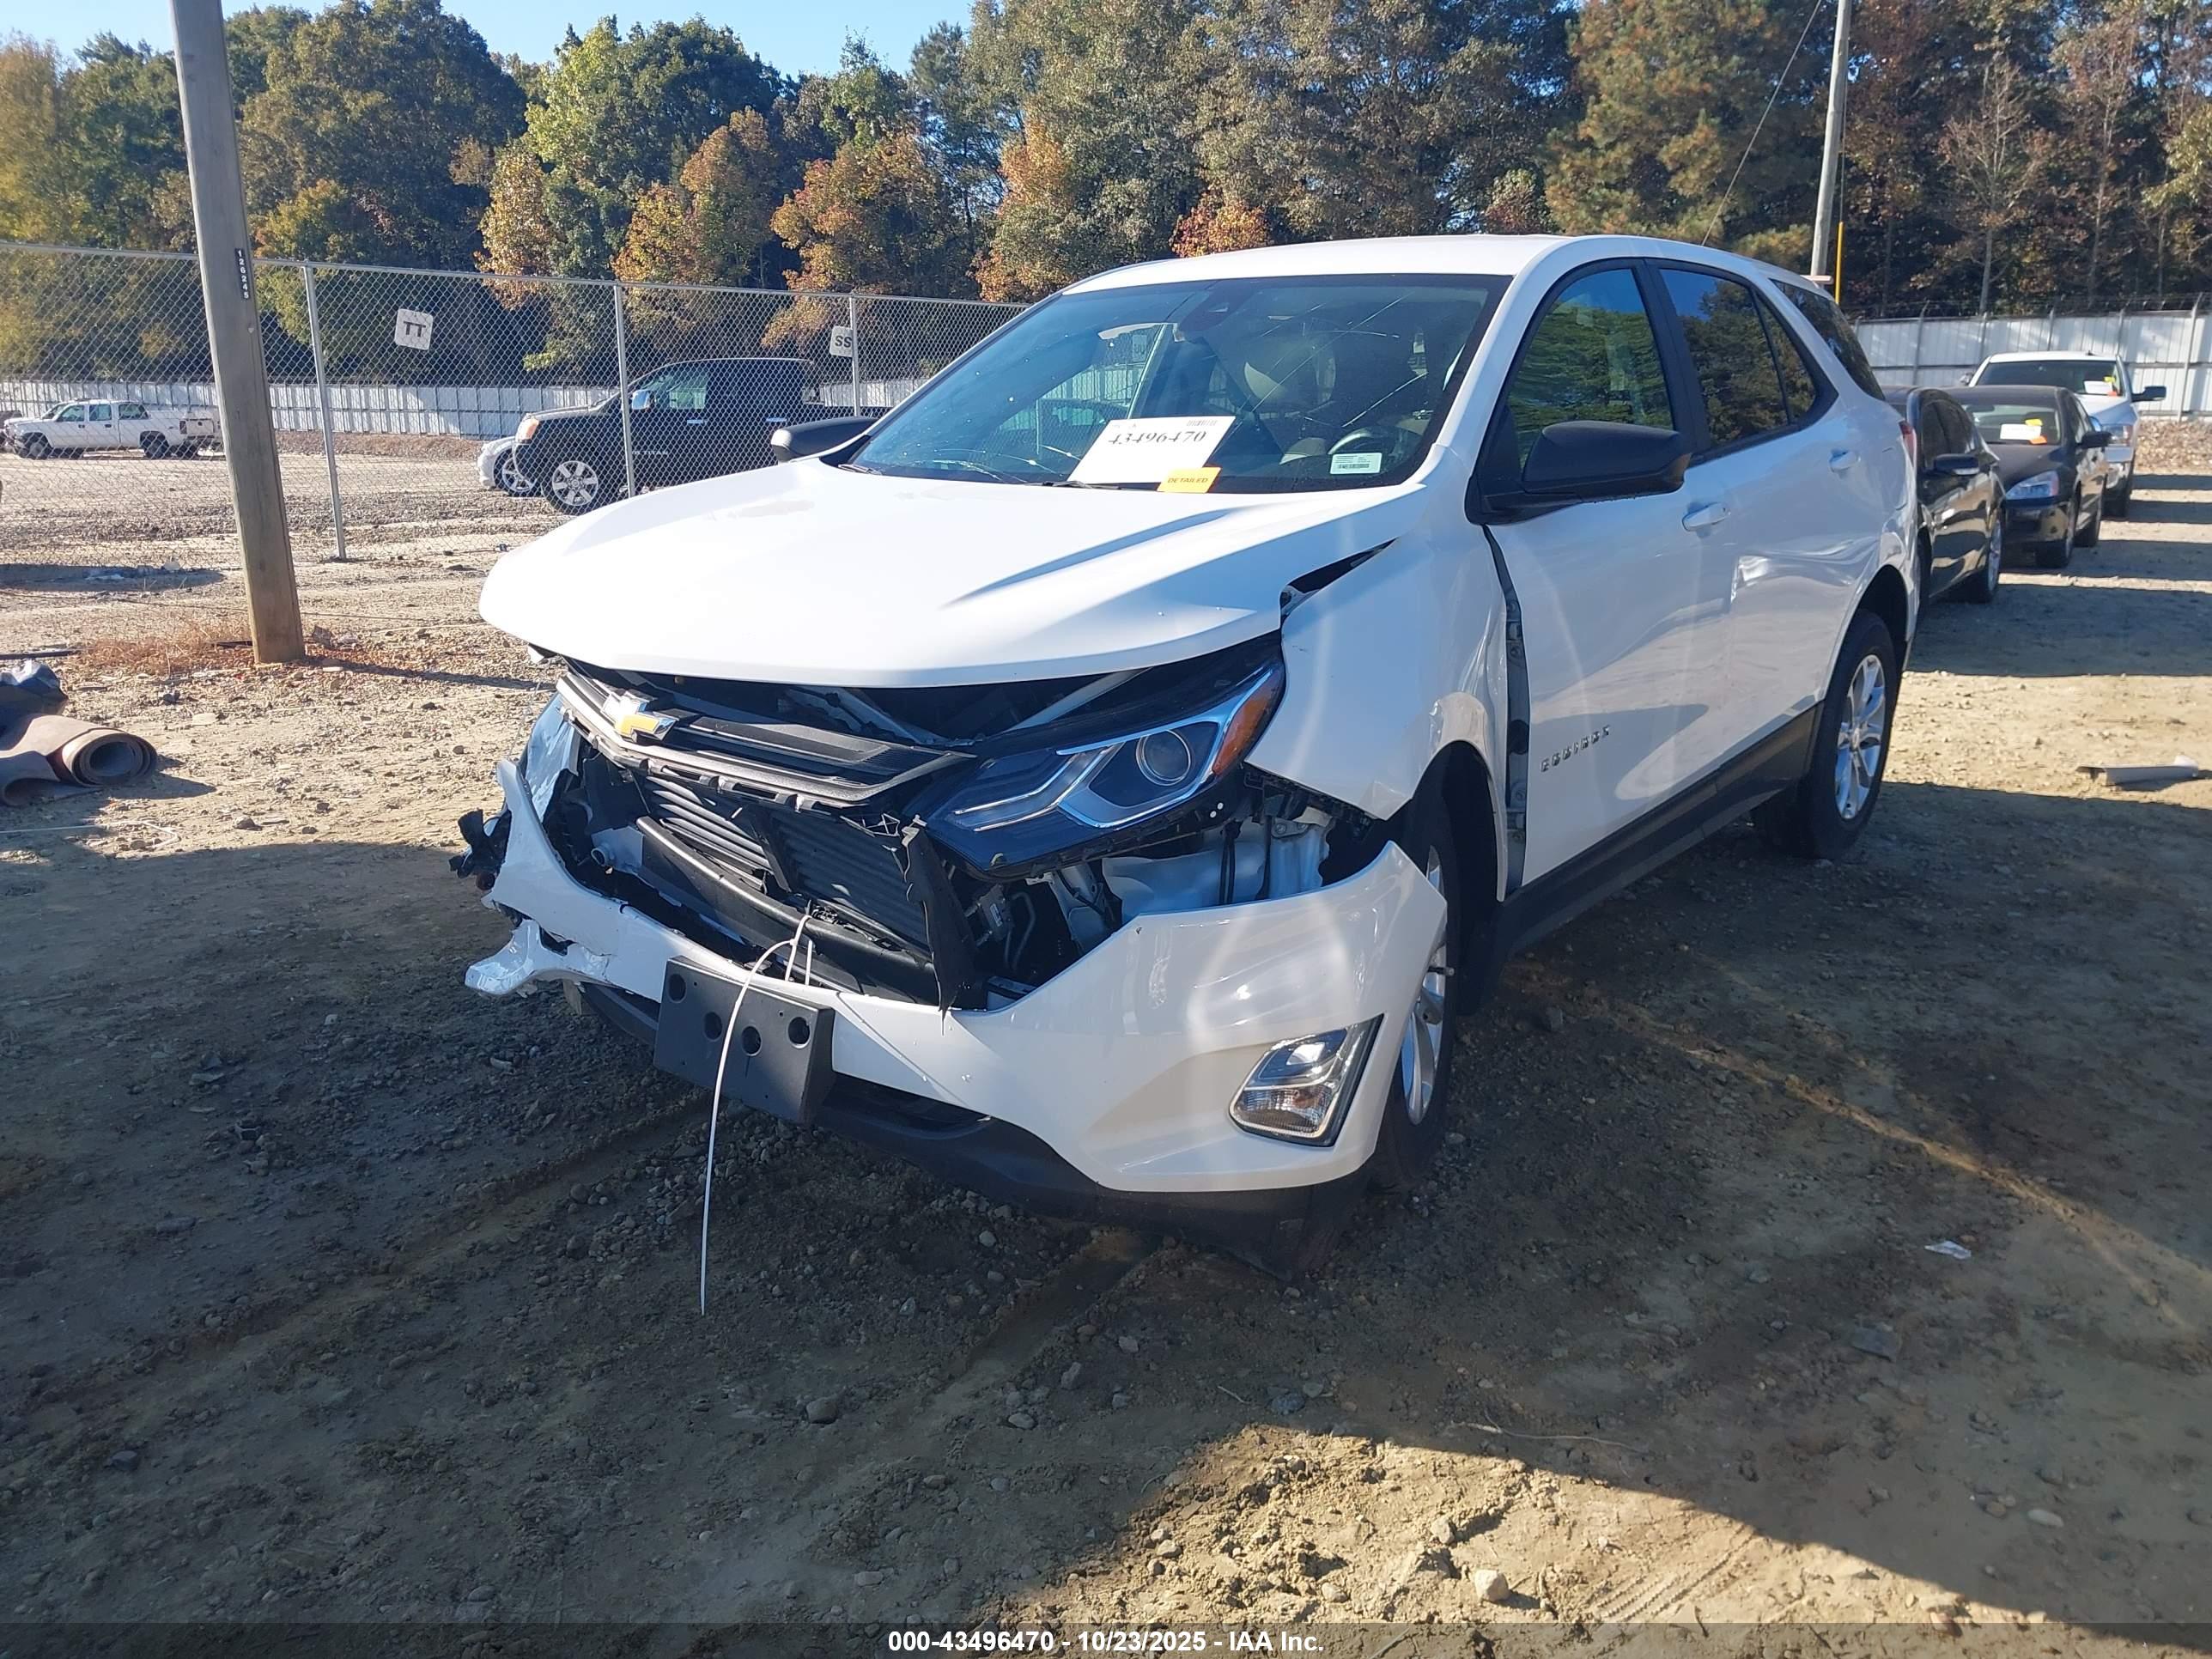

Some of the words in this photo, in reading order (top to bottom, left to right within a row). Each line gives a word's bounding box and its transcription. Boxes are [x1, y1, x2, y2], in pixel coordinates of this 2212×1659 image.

[238, 249, 249, 299] 126245
[403, 320, 427, 337] TT
[835, 335, 853, 348] SS
[1109, 431, 1207, 445] 43496470
